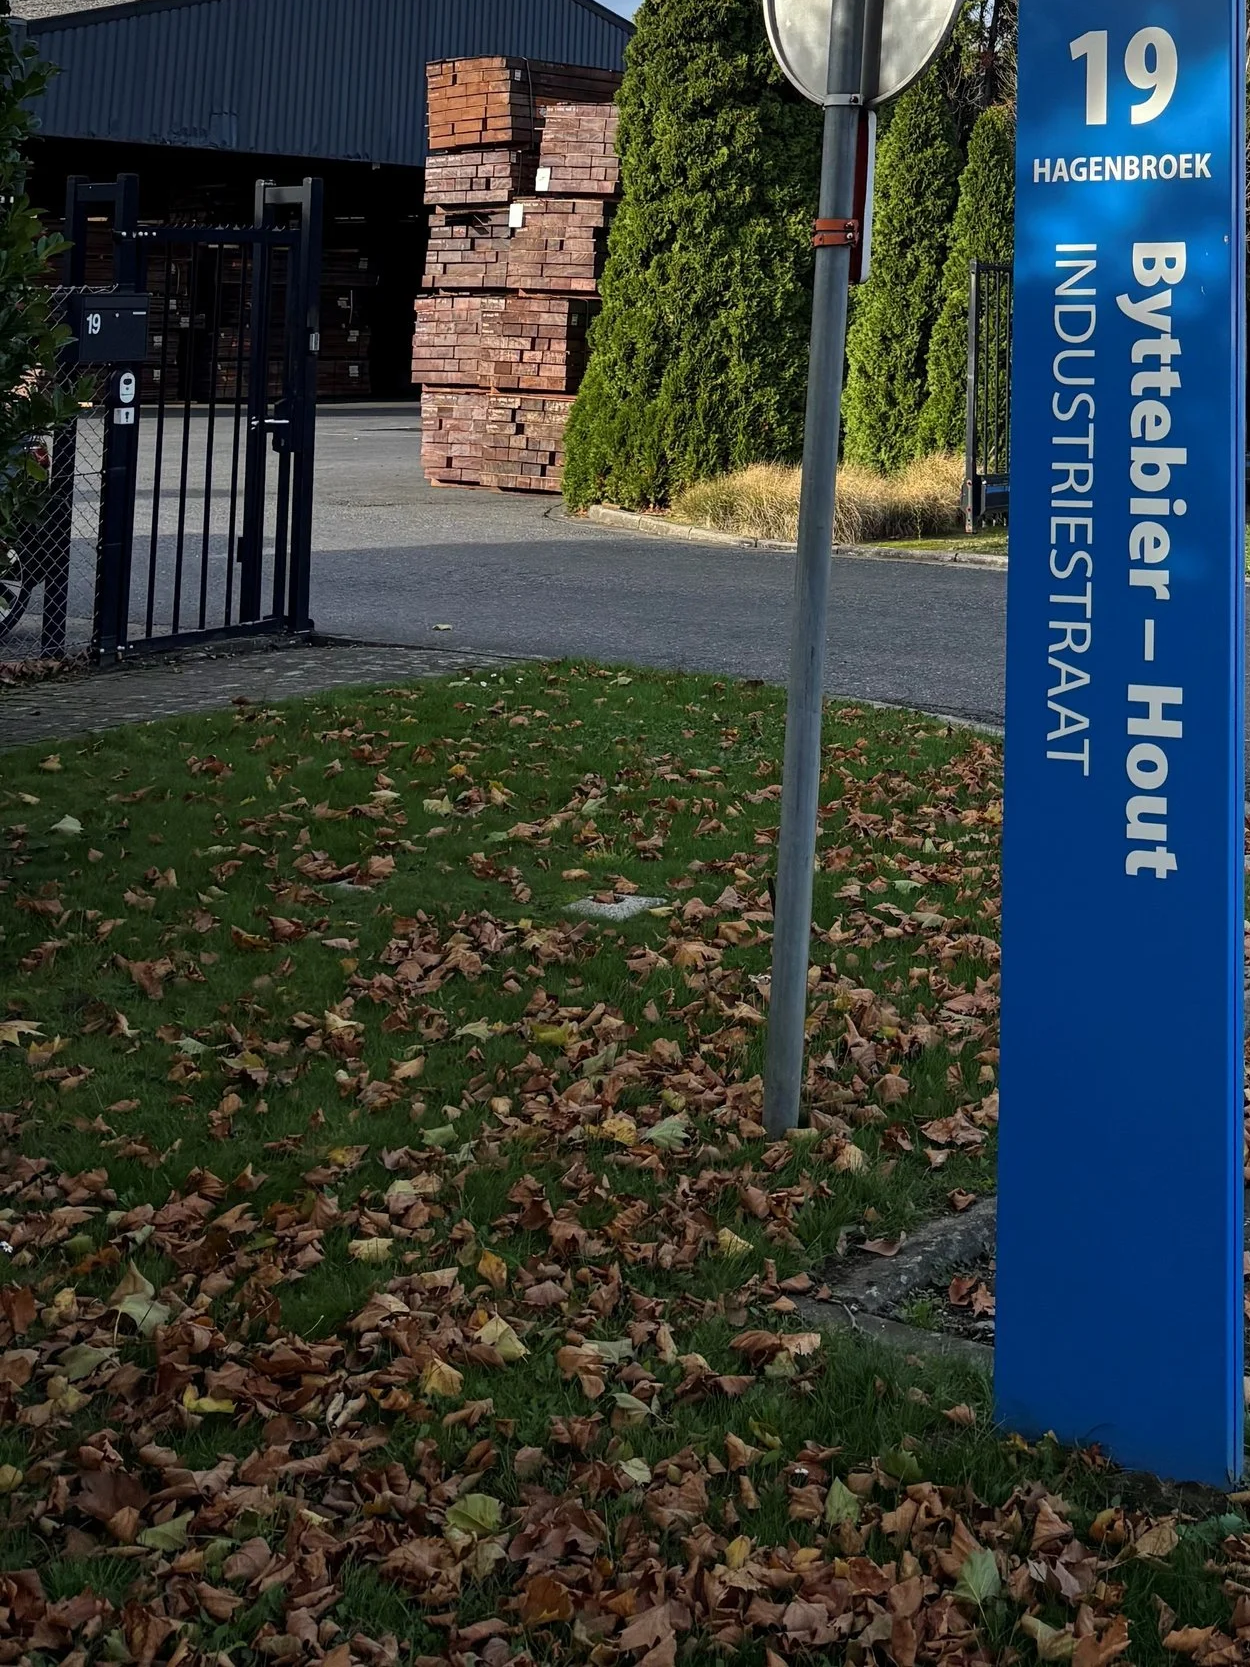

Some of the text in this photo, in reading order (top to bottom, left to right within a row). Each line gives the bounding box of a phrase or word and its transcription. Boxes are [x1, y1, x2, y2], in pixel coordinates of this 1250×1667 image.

[1069, 26, 1178, 126] 19
[1033, 152, 1212, 183] HAGENBROEK
[86, 313, 101, 335] 19
[1115, 241, 1187, 600] Byttebier
[1046, 243, 1097, 776] INDUSTRIESTRAAT
[1126, 684, 1183, 879] Hout
